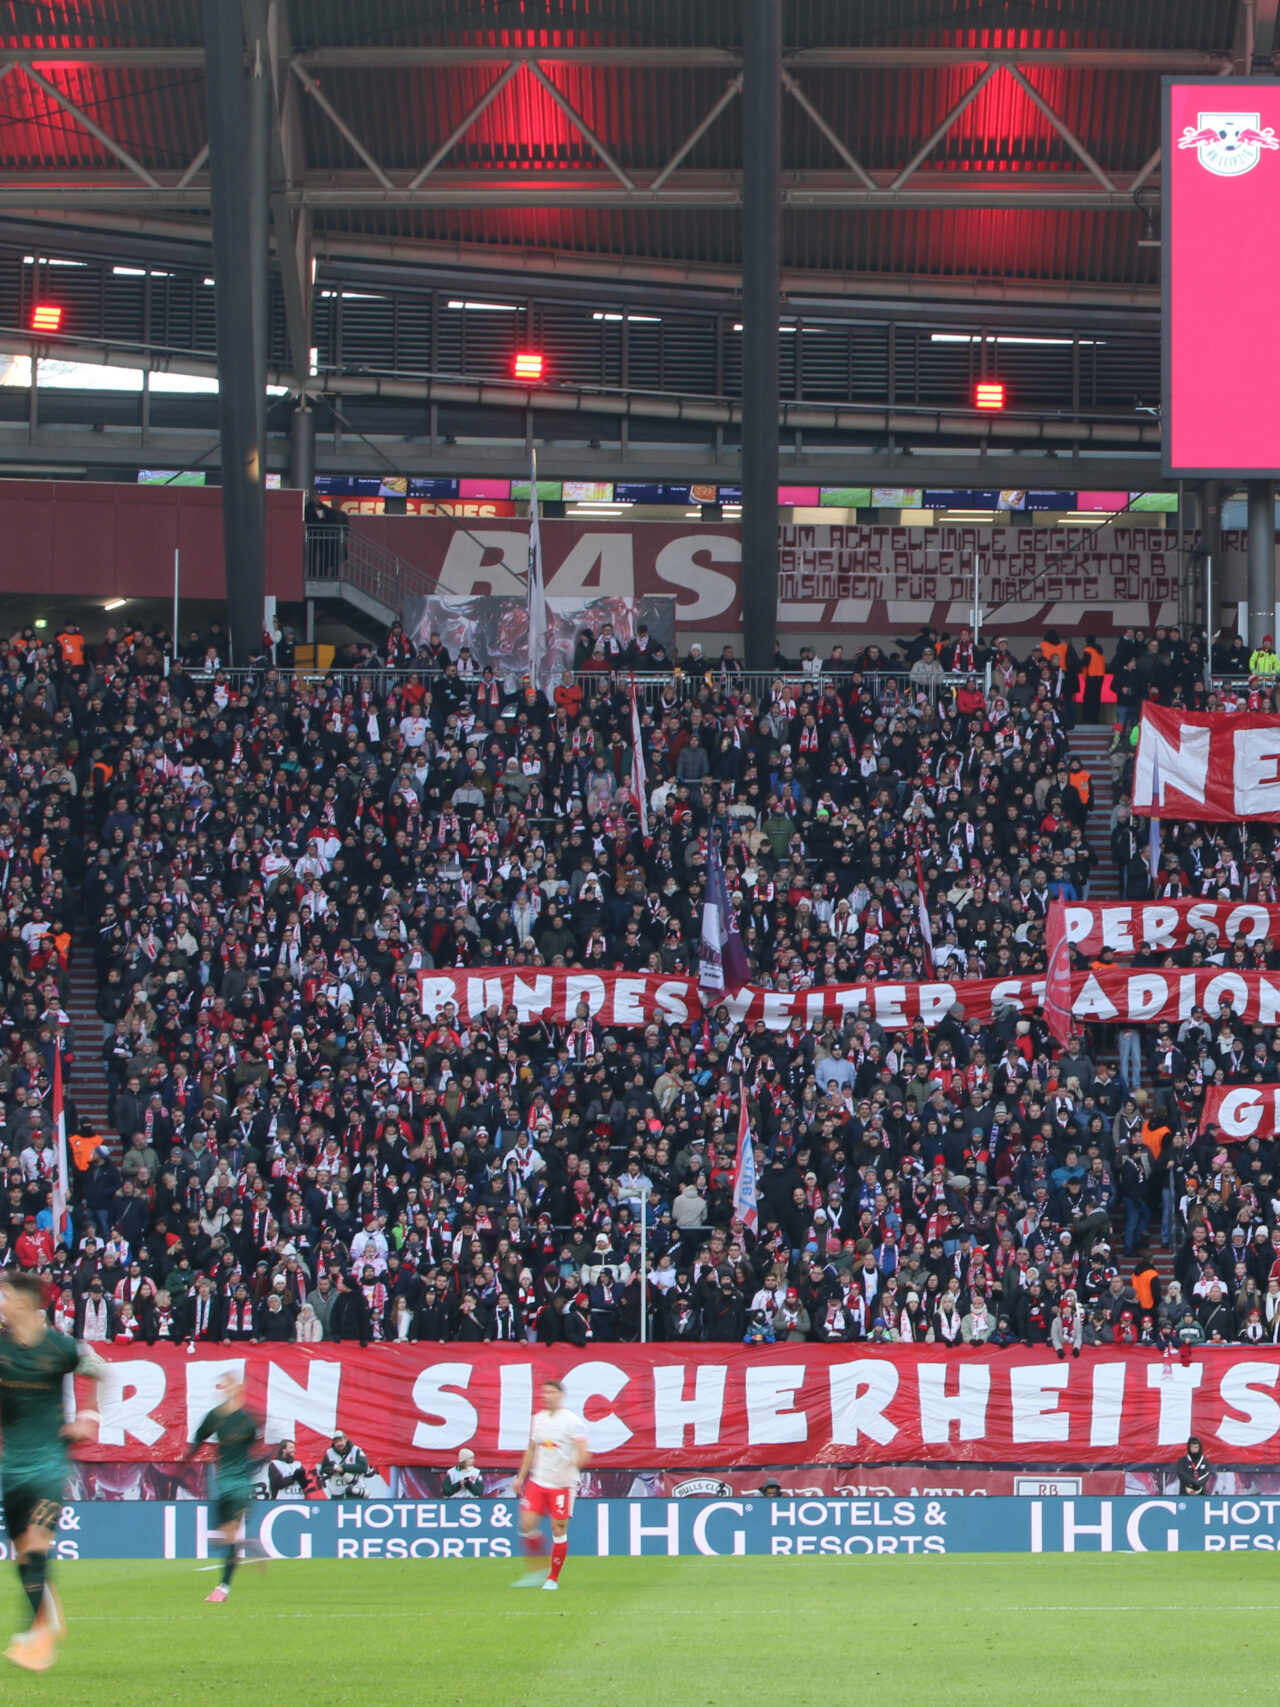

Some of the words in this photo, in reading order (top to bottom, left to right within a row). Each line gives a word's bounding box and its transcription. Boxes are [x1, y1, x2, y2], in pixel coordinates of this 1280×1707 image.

[778, 525, 815, 549] UM
[829, 525, 1006, 551] ACHTELFINALE
[1017, 527, 1099, 551] GEGEN
[894, 552, 955, 576] ALLE
[1044, 552, 1141, 577] SEKTOR
[895, 576, 937, 601] FÜR
[991, 576, 1099, 602] NÄCHSTE
[677, 1483, 703, 1497] BULLS
[59, 1505, 81, 1530] &
[337, 1503, 483, 1529] HOTELS
[489, 1503, 513, 1529] &
[771, 1501, 916, 1527] HOTELS
[923, 1501, 948, 1527] &
[1031, 1500, 1179, 1553] IHG
[597, 1502, 746, 1557] IHG
[337, 1537, 512, 1559] RESORTS
[771, 1535, 947, 1555] RESORTS
